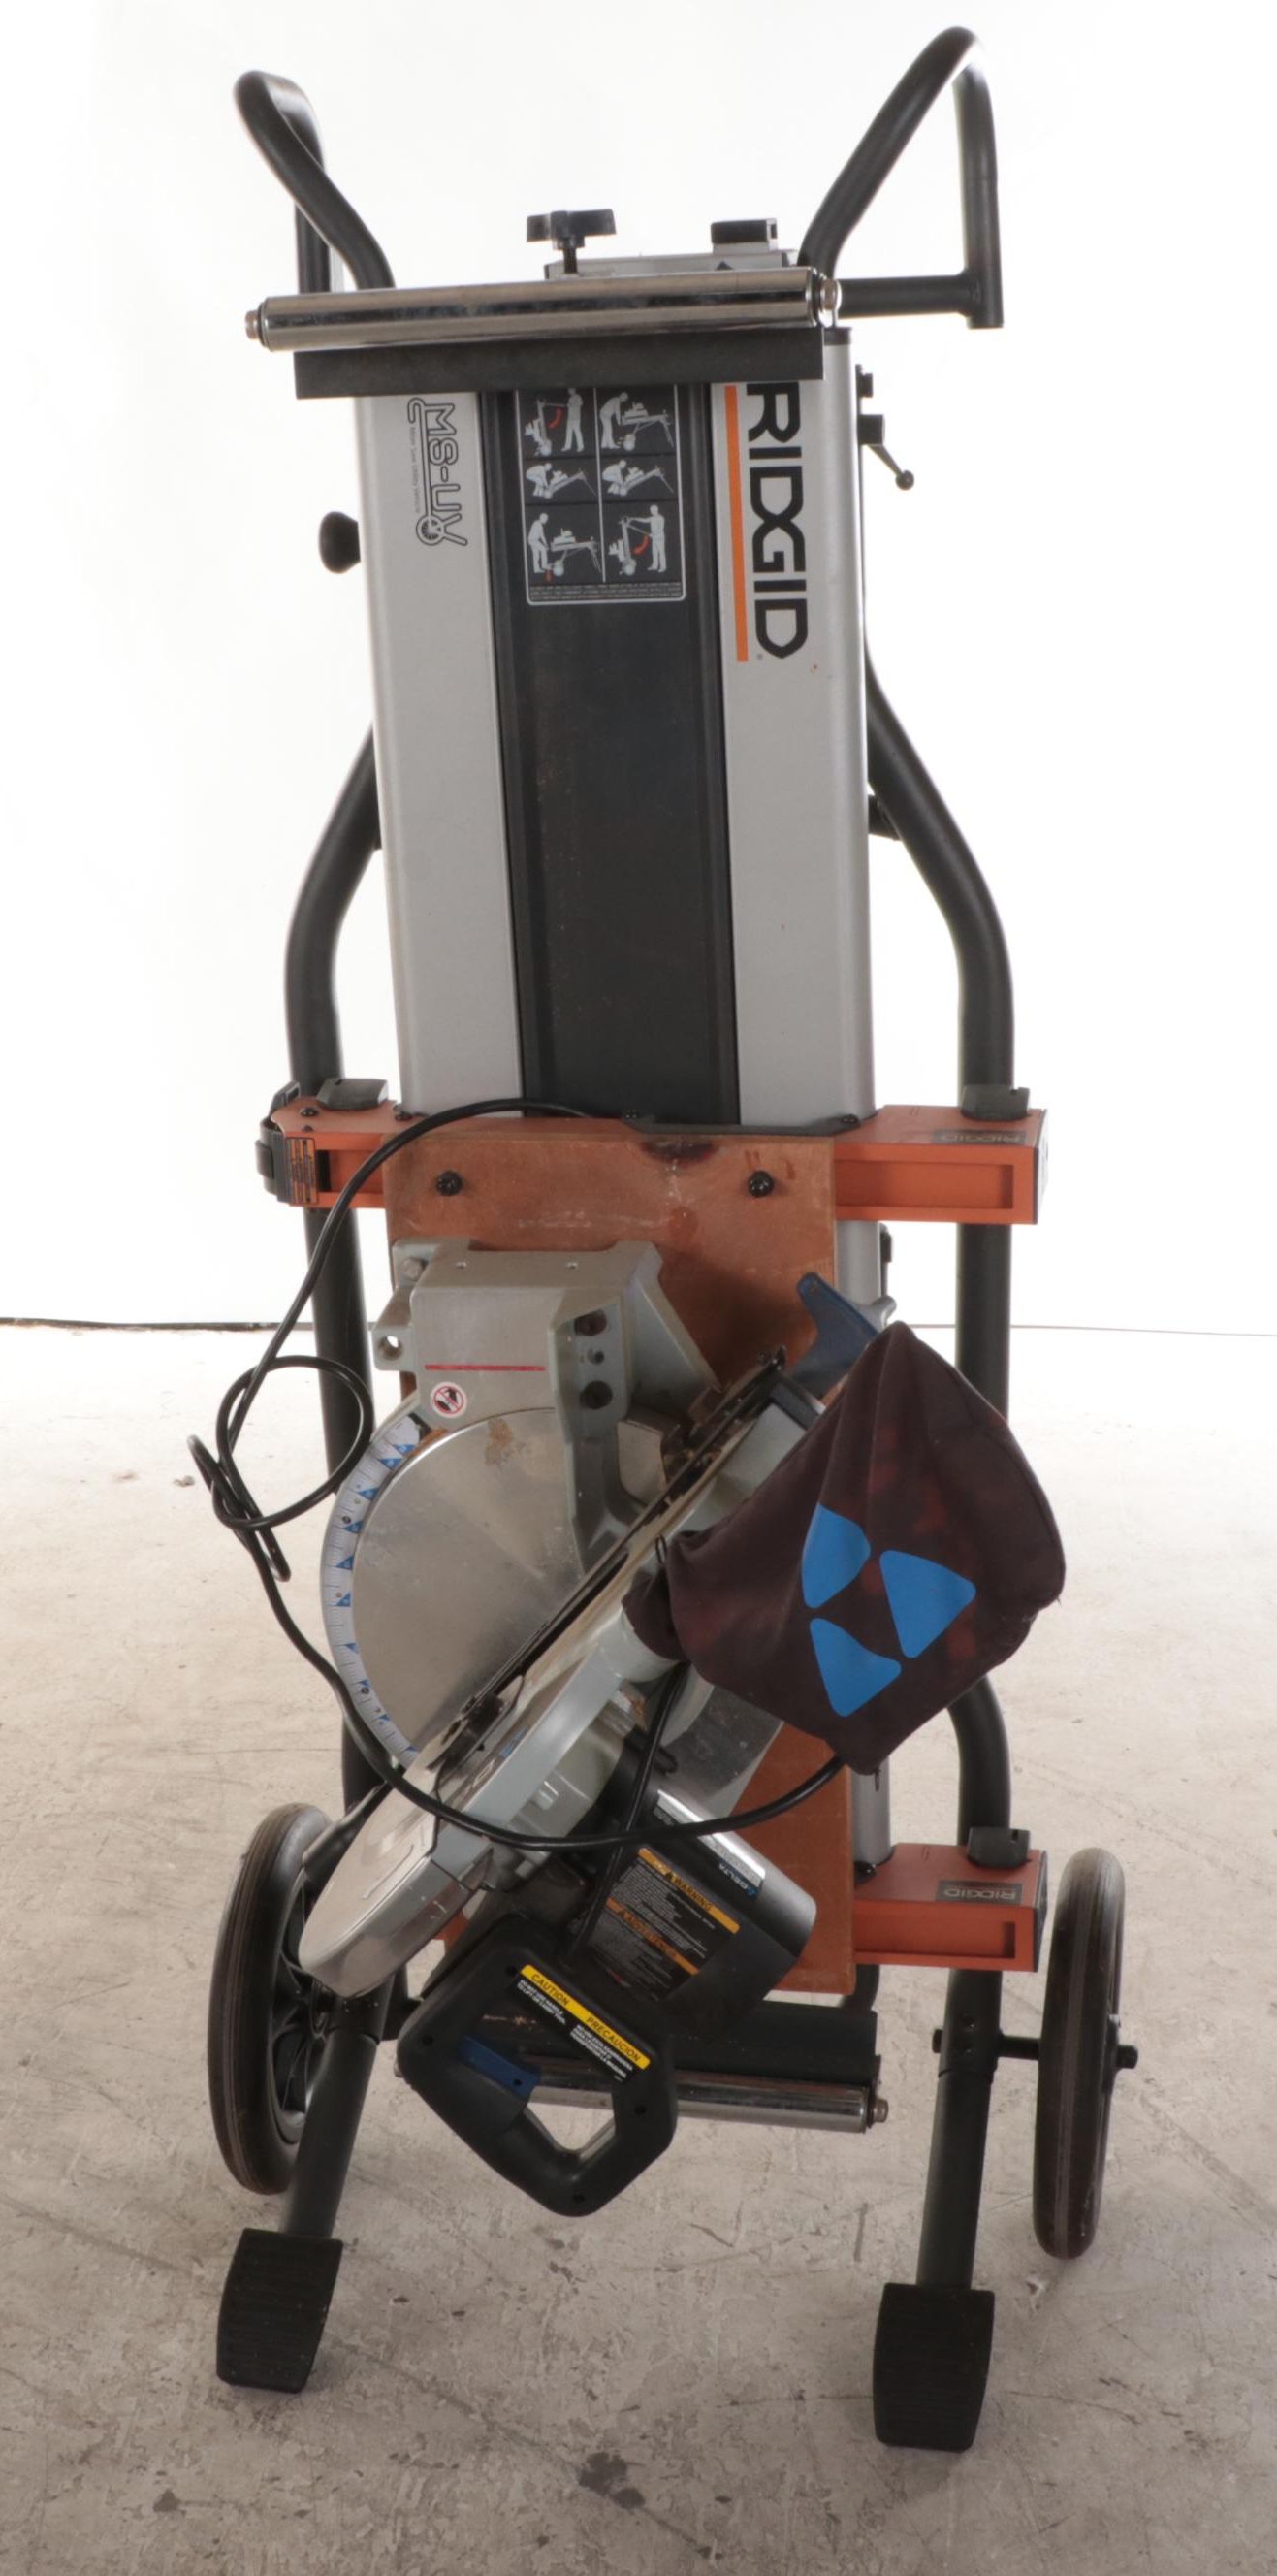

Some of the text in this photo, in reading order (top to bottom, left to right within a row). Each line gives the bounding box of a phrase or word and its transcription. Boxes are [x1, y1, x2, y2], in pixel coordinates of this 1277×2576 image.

[416, 402, 468, 546] MS-UV
[746, 382, 809, 659] RIDGID
[672, 1877, 713, 1911] WARNING
[944, 1888, 1016, 1900] RIDGID
[531, 1973, 569, 2006] CAUTION
[586, 2017, 641, 2062] PRECAUCION
